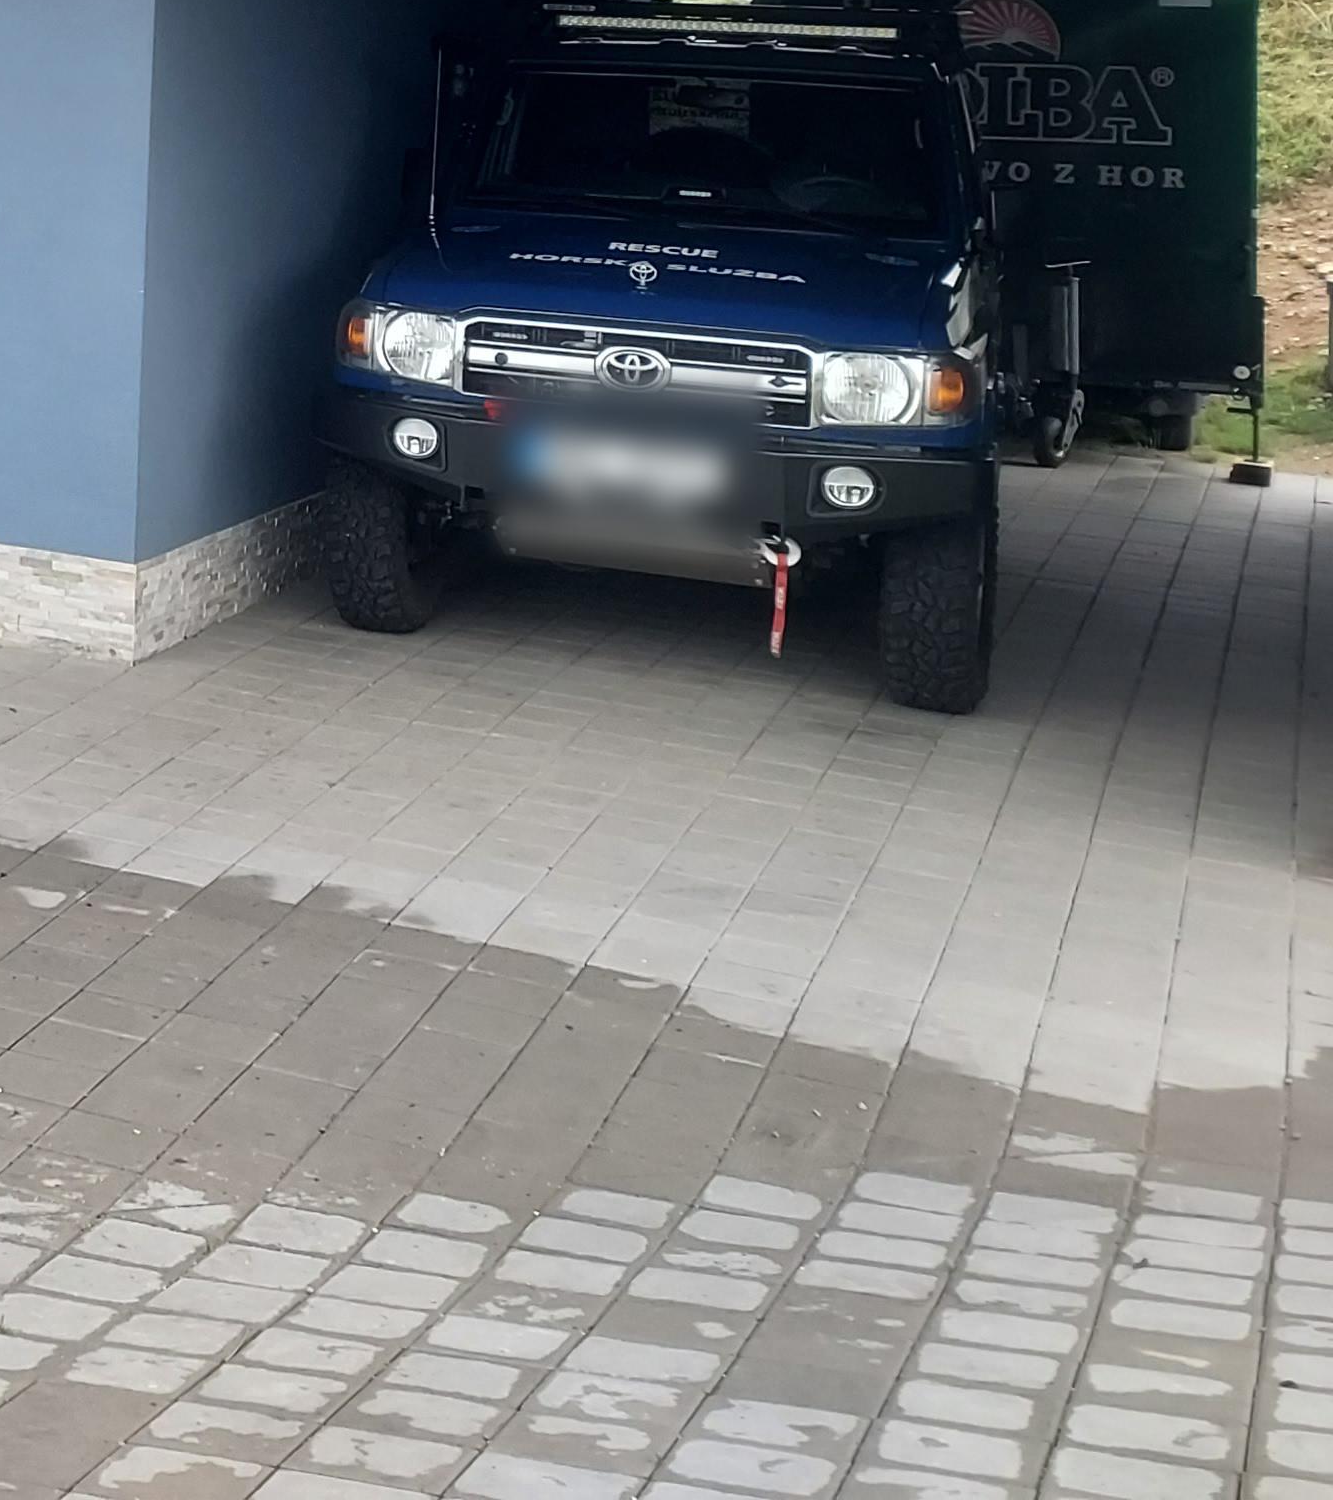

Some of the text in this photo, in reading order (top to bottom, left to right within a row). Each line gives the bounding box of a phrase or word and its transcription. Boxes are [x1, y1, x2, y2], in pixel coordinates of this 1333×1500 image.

[1053, 163, 1076, 184] Z
[1097, 164, 1186, 189] HOR
[607, 241, 720, 259] RESCUE
